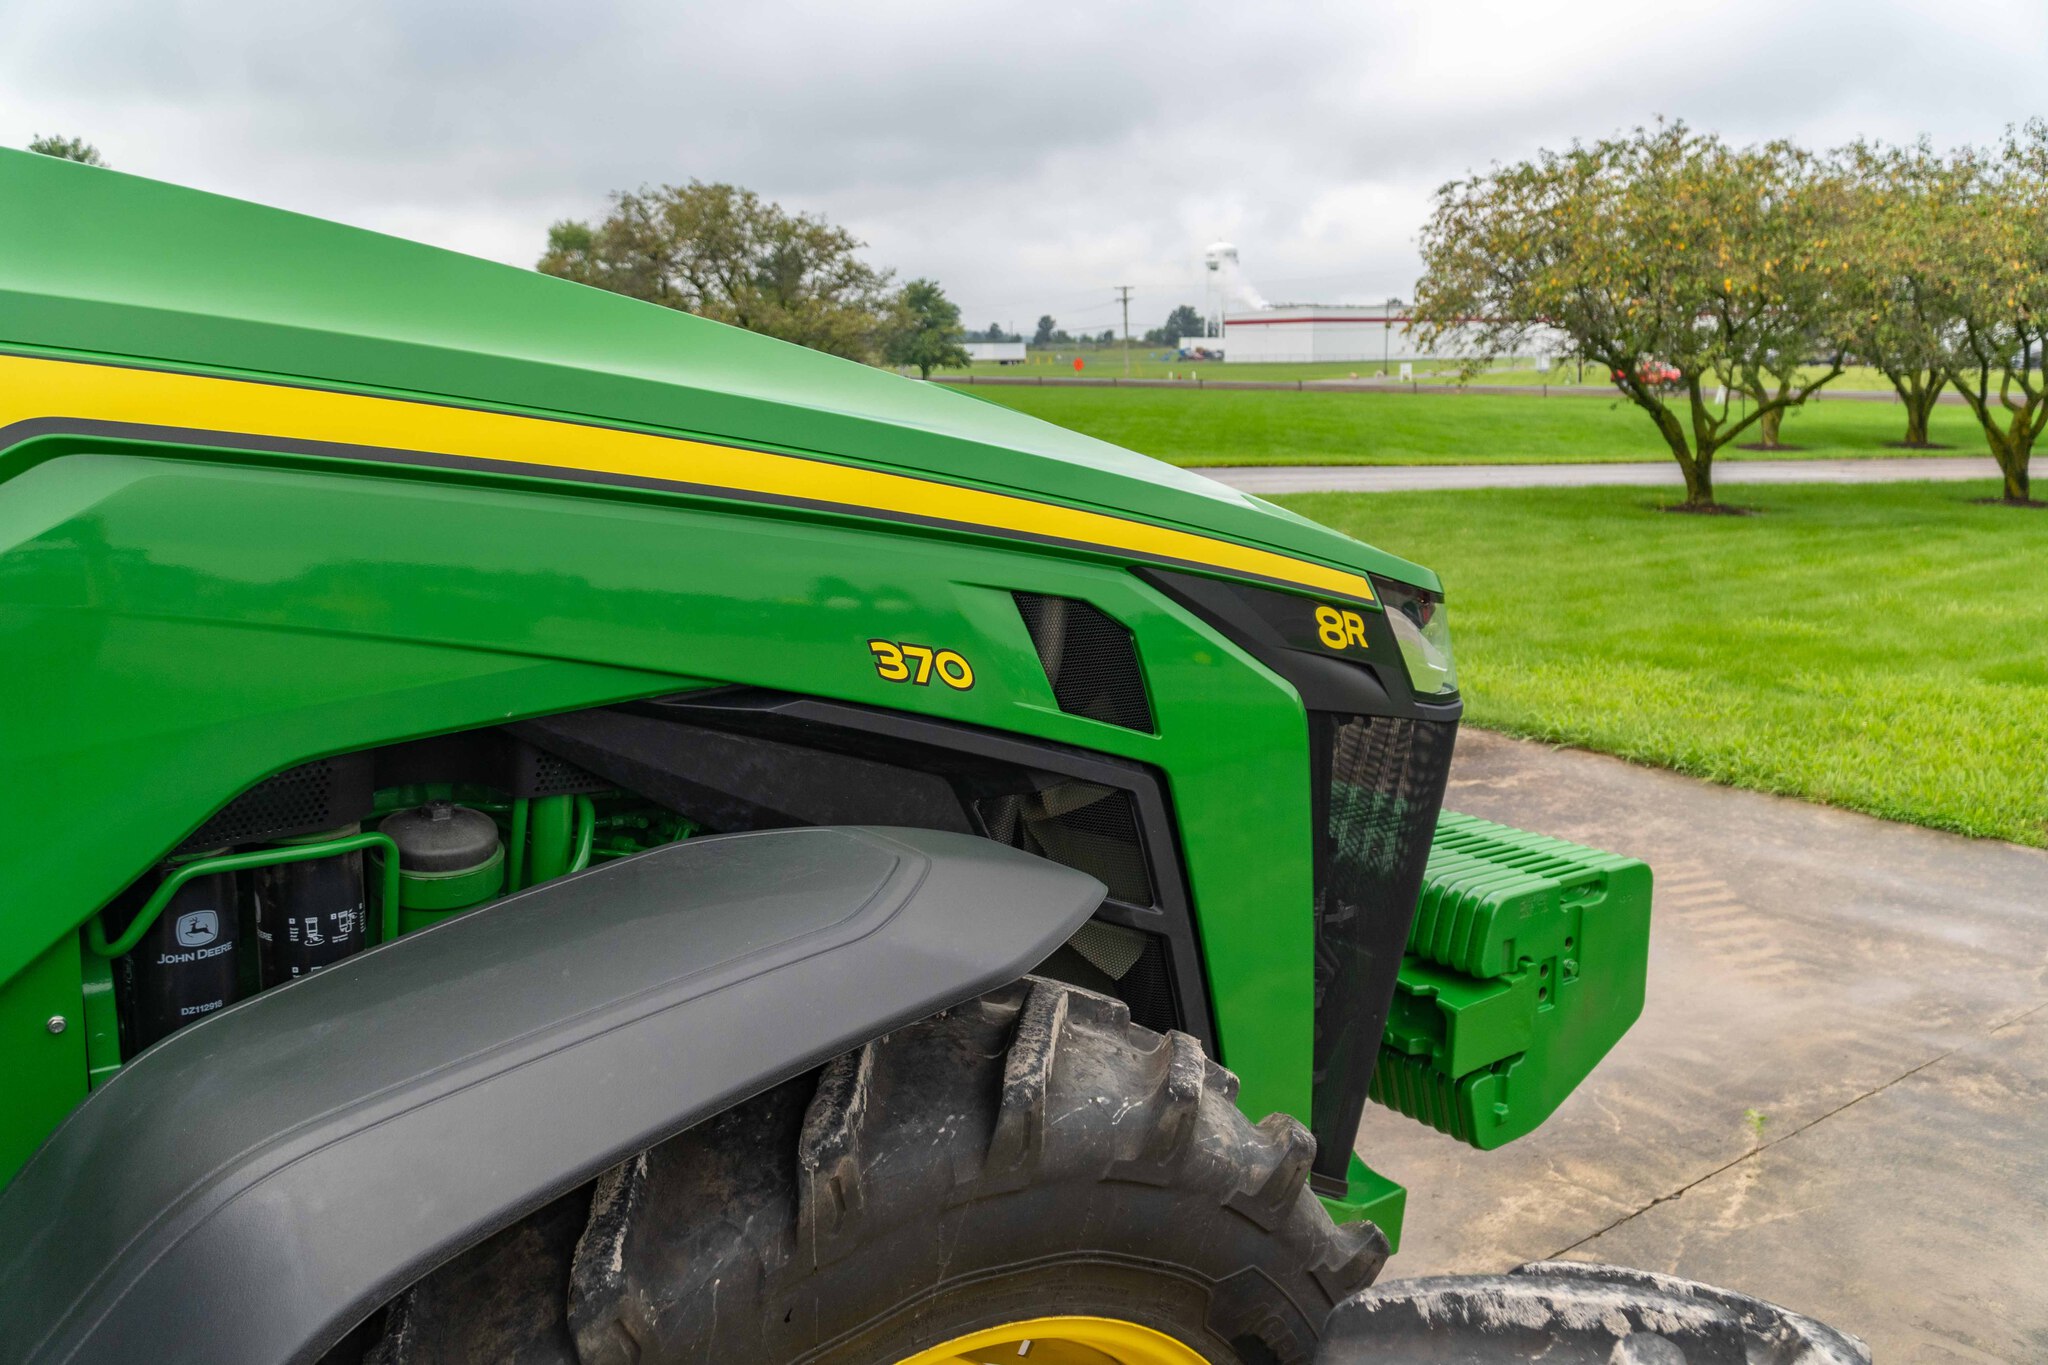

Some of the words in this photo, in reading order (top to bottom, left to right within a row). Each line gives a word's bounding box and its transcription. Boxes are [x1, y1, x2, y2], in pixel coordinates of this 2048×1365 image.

[1315, 606, 1369, 650] 8R
[867, 638, 976, 692] 370
[156, 952, 196, 965] JOHN
[197, 941, 233, 960] DEERE
